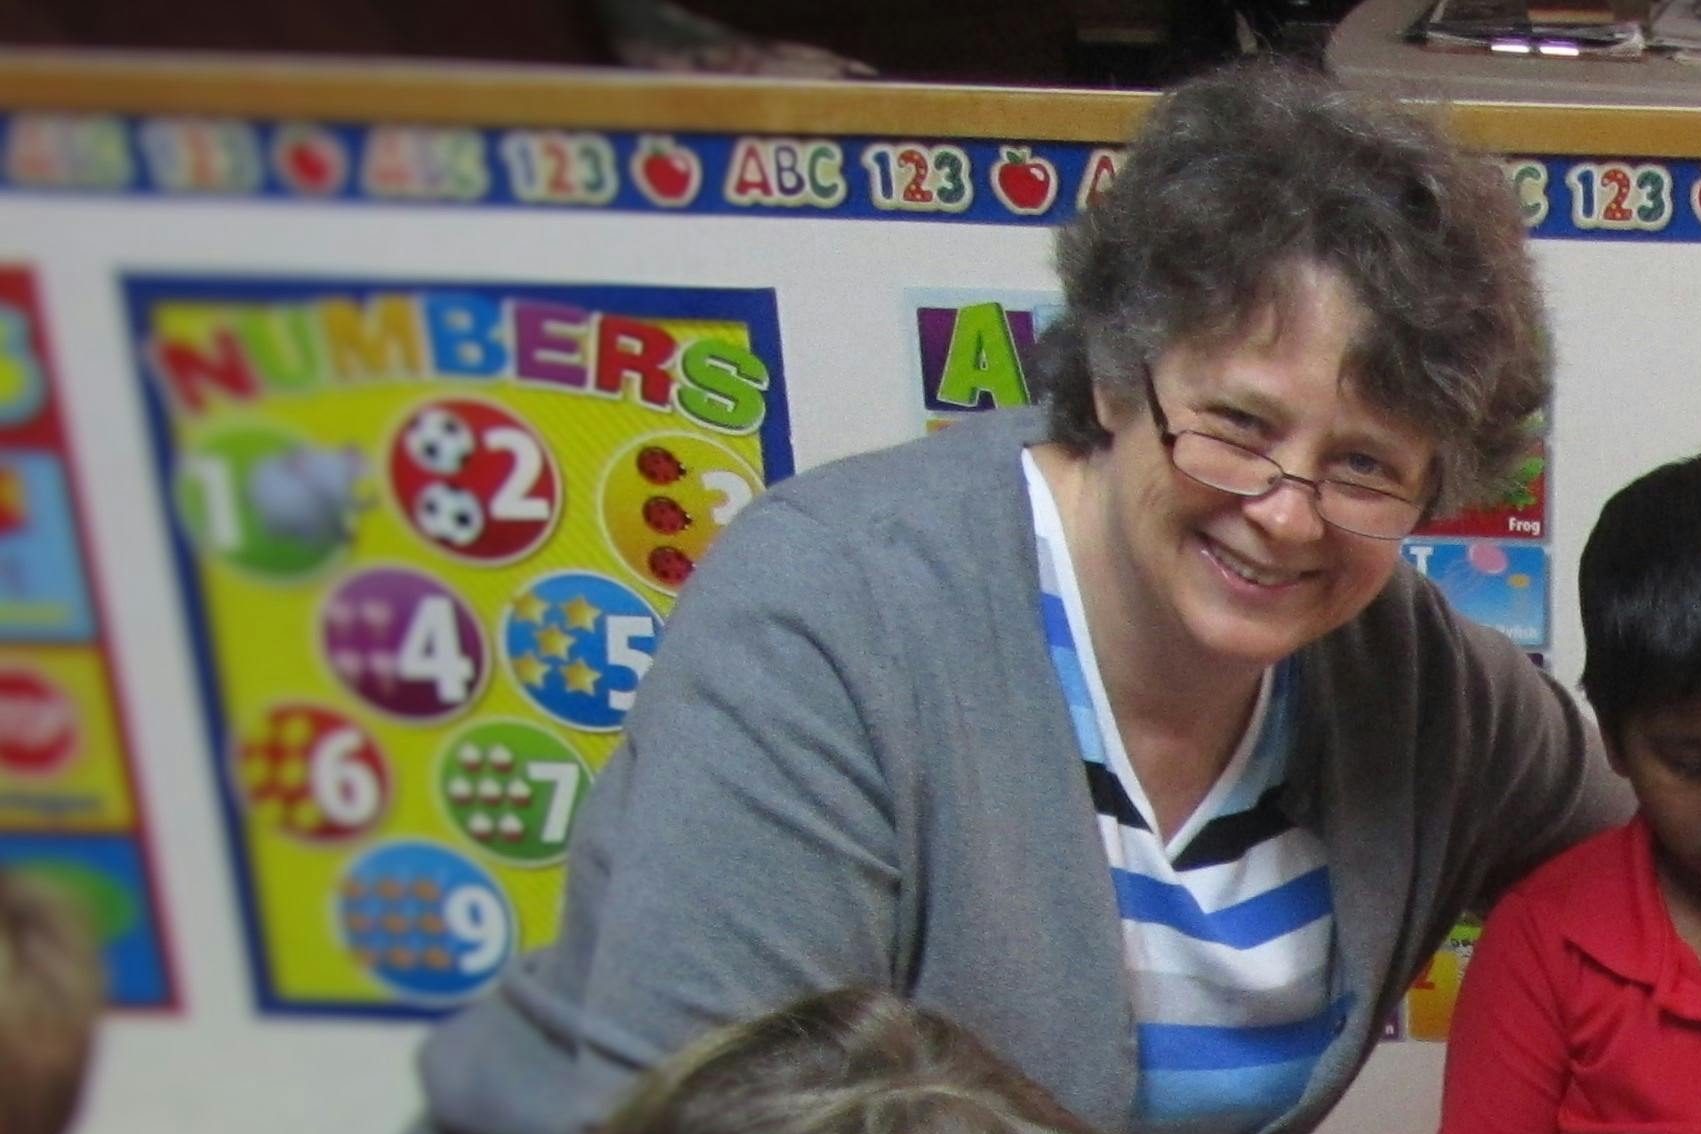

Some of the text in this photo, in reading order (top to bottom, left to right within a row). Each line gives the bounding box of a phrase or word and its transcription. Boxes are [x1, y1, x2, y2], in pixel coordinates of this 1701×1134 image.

[512, 137, 609, 197] 123
[733, 143, 840, 200] ABC
[870, 148, 969, 205] 123
[1572, 168, 1671, 223] 123
[152, 292, 768, 434] NUMBERS
[486, 428, 551, 521] 2
[1508, 517, 1541, 536] Frog
[399, 596, 473, 702] 4
[605, 615, 656, 711] 5
[309, 729, 381, 826] 6
[526, 762, 580, 844] 7
[444, 885, 504, 974] 9
